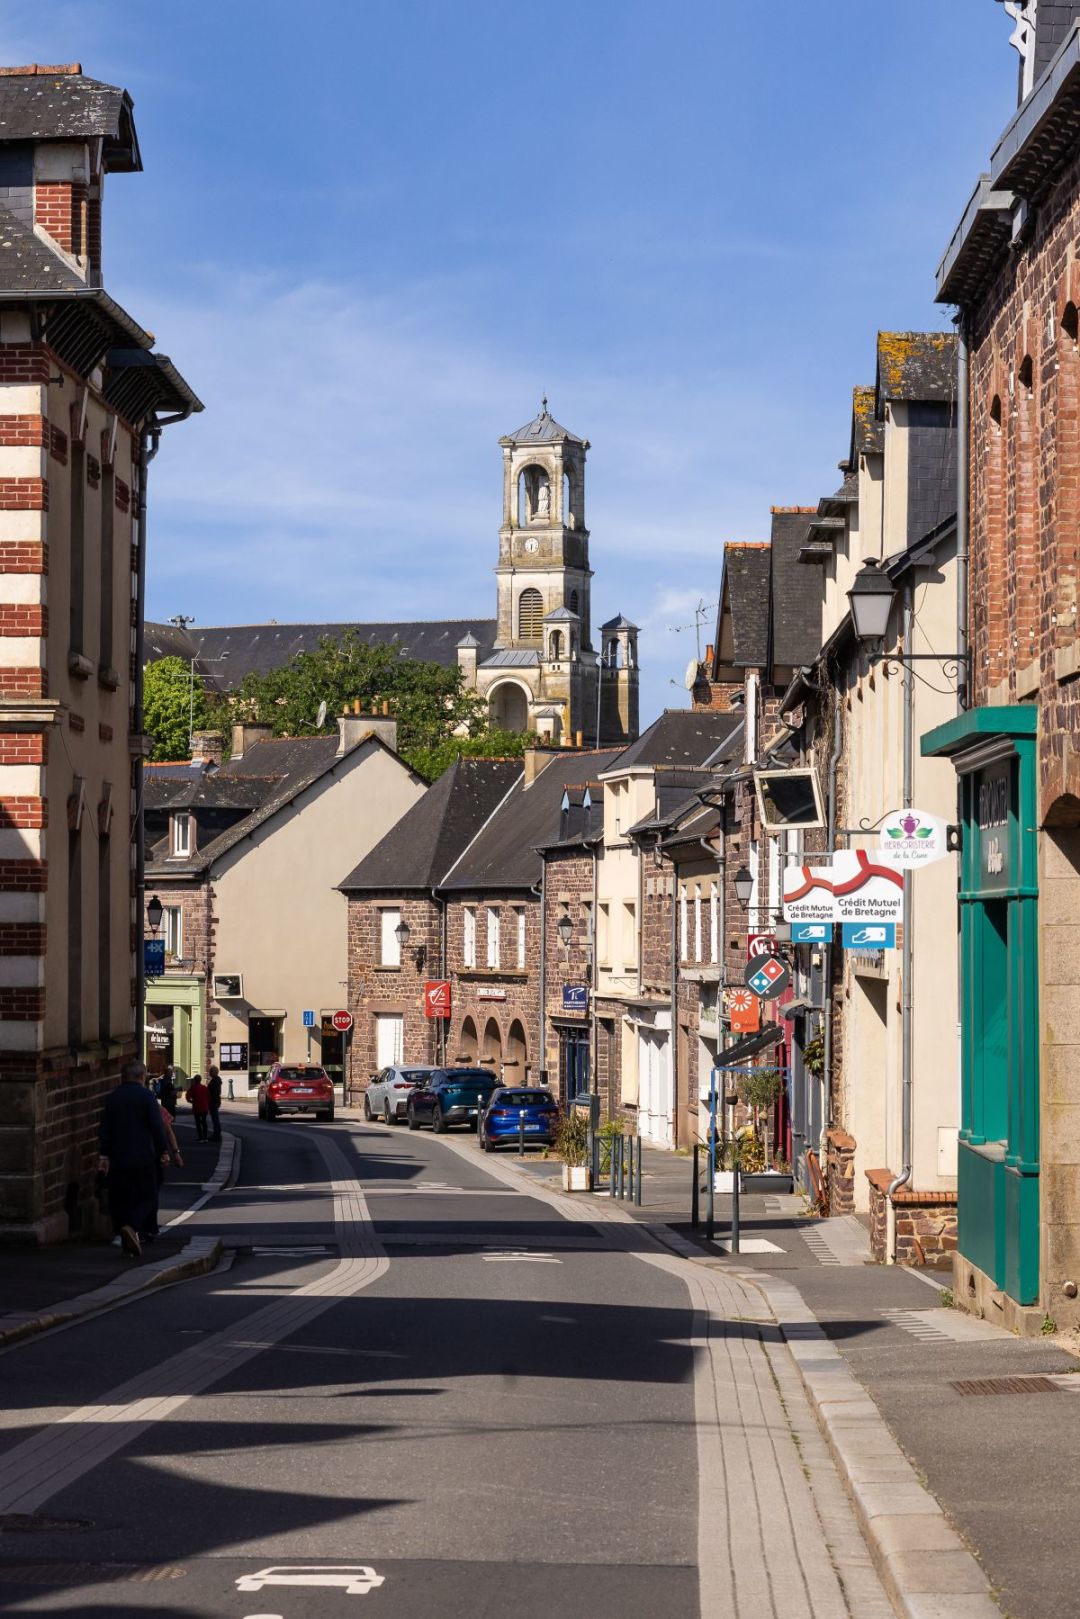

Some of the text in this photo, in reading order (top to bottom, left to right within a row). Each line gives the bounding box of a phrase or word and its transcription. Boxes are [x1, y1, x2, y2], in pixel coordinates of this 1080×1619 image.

[884, 840, 935, 849] HERBORISTERIE
[893, 851, 901, 859] de
[838, 898, 901, 907] Crédit Mutuel
[787, 904, 810, 912] Crédit
[841, 908, 897, 917] de Bretagne
[334, 1016, 351, 1024] STOP
